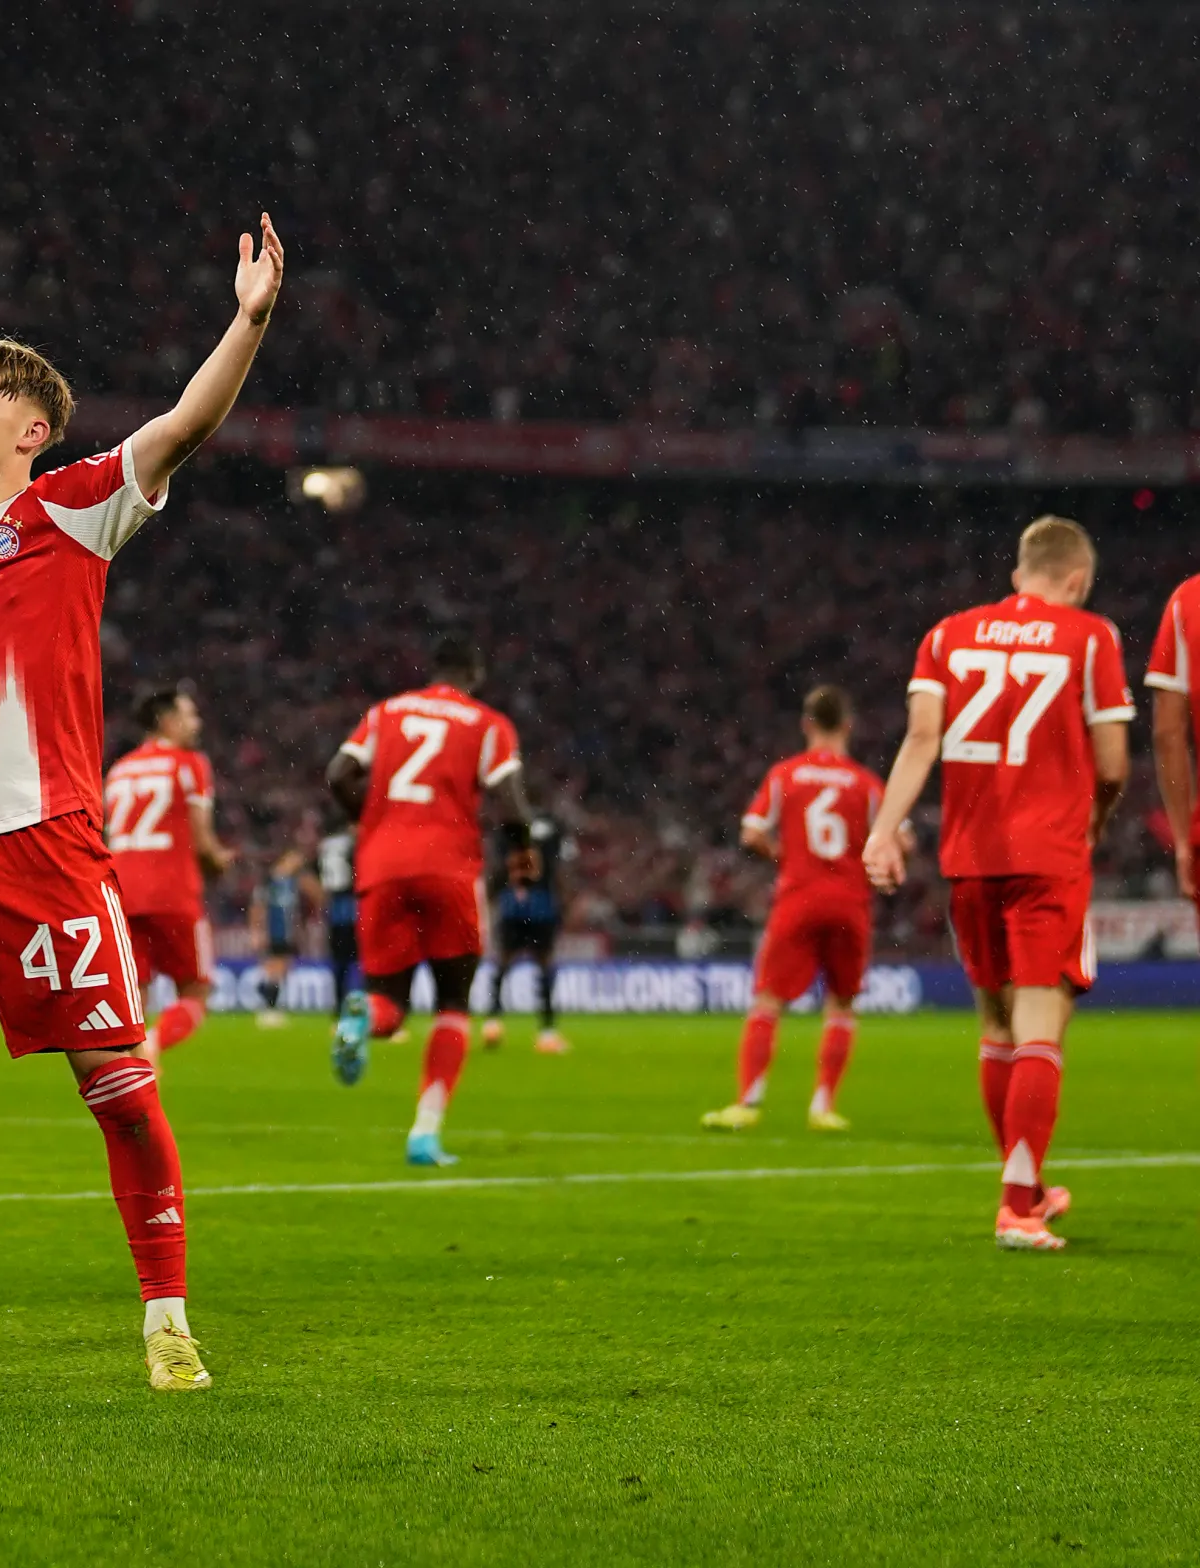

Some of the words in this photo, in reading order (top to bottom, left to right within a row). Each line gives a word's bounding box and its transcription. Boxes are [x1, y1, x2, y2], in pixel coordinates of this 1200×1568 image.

[941, 648, 1072, 767] 27
[387, 714, 450, 805] 2
[105, 775, 174, 853] 22
[805, 786, 848, 860] 6
[20, 916, 109, 990] 42
